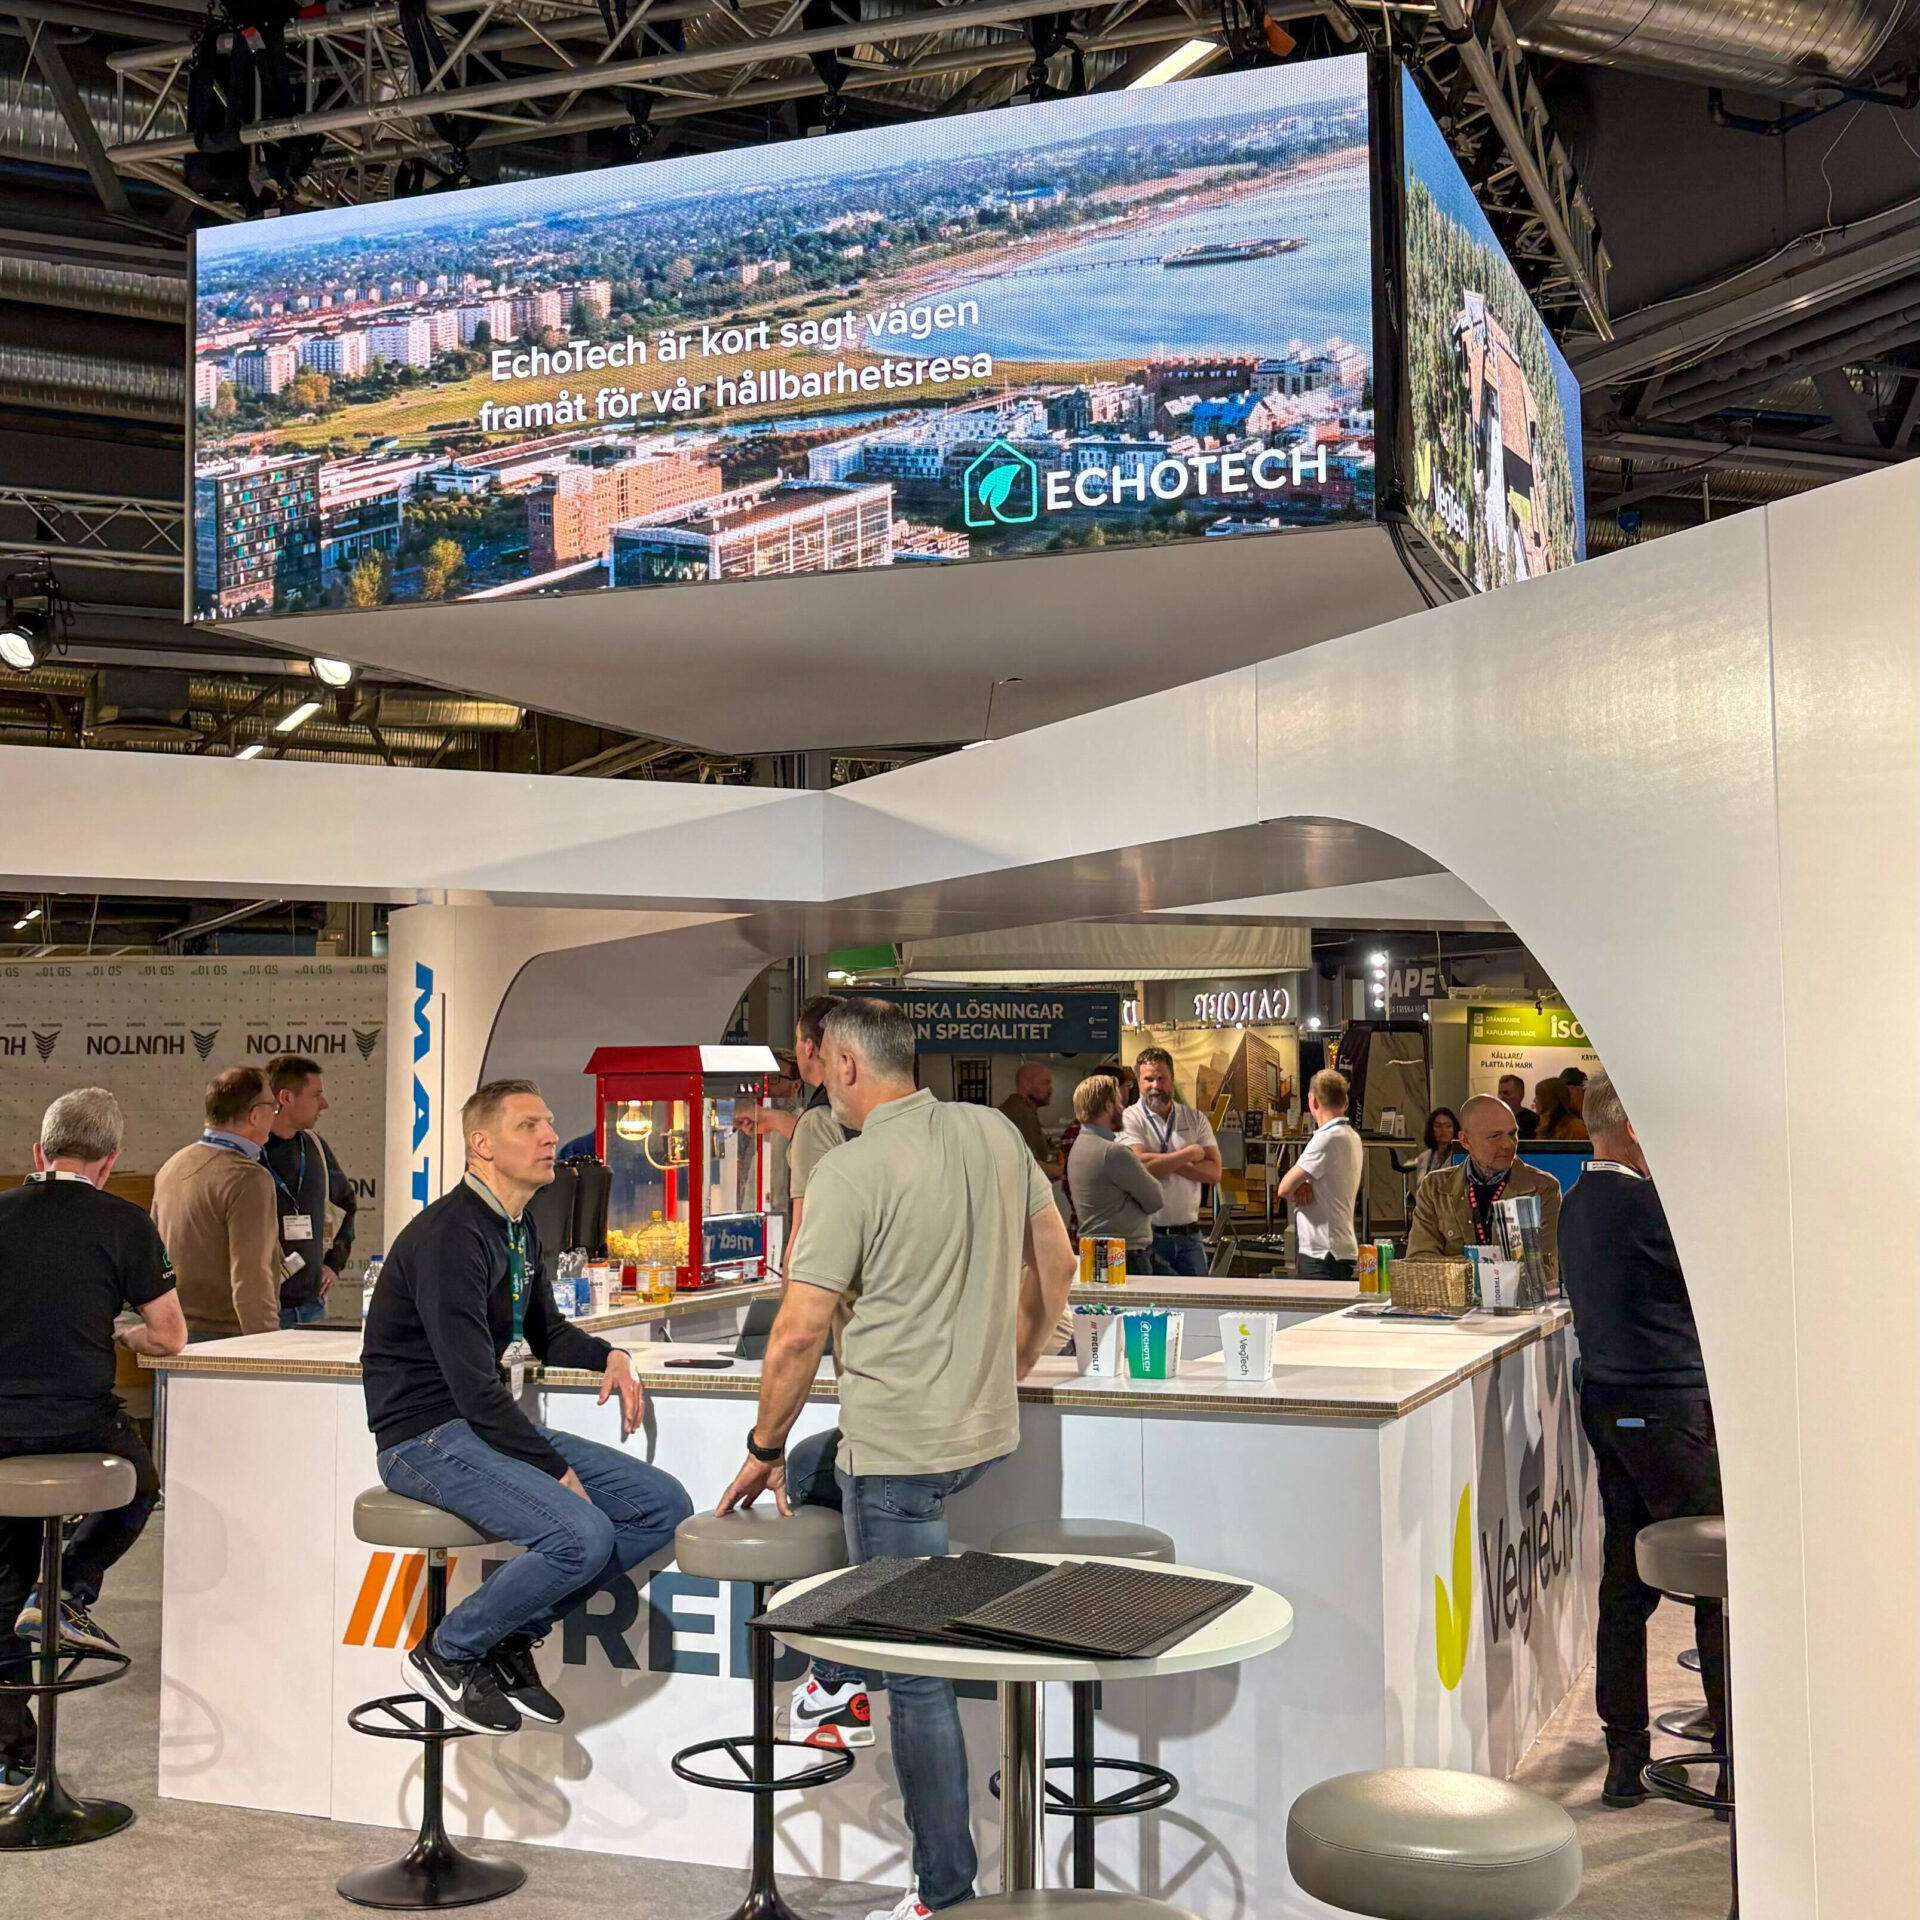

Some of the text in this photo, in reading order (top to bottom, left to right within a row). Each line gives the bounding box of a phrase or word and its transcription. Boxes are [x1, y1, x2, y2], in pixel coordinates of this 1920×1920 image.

[490, 300, 979, 382] EchoTech är kort sagt vägen
[479, 351, 993, 432] framåt för vår hållbarhetsresa
[1046, 444, 1327, 511] ECHOTECH
[1433, 467, 1470, 544] VegTech
[956, 999, 1064, 1019] LÖSNINGAR
[87, 1035, 185, 1055] HUNTON
[246, 1034, 346, 1054] HUNTON
[935, 1023, 1052, 1040] SPECIALITET
[1505, 1060, 1514, 1069] PÅ
[1090, 1331, 1100, 1372] TREBOLIT
[1143, 1333, 1152, 1372] ECHOTECH
[1238, 1338, 1249, 1377] VegTech
[1480, 1464, 1574, 1645] VegTech
